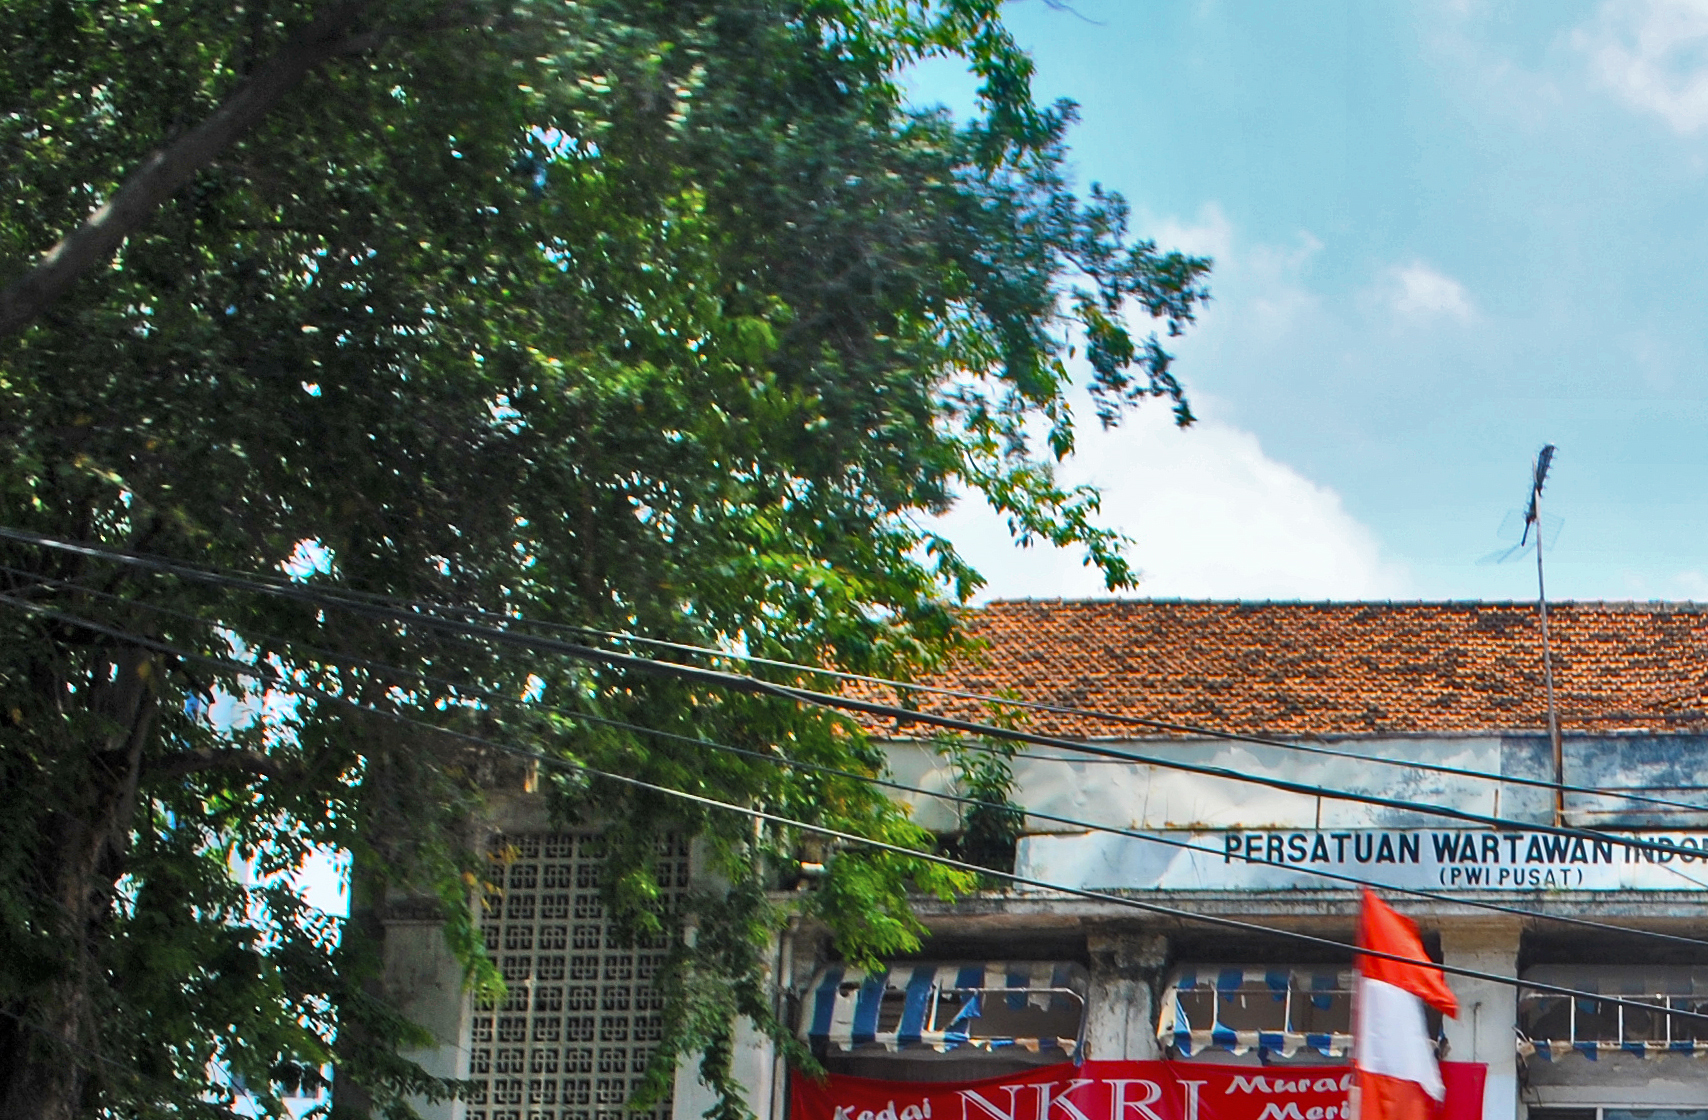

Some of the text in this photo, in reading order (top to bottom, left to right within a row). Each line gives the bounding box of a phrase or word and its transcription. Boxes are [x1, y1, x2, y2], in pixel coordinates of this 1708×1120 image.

[1224, 832, 1421, 865] PERSATUAN
[1433, 832, 1613, 864] WARTAWAN
[1438, 867, 1584, 887] (PWI PUSAT)
